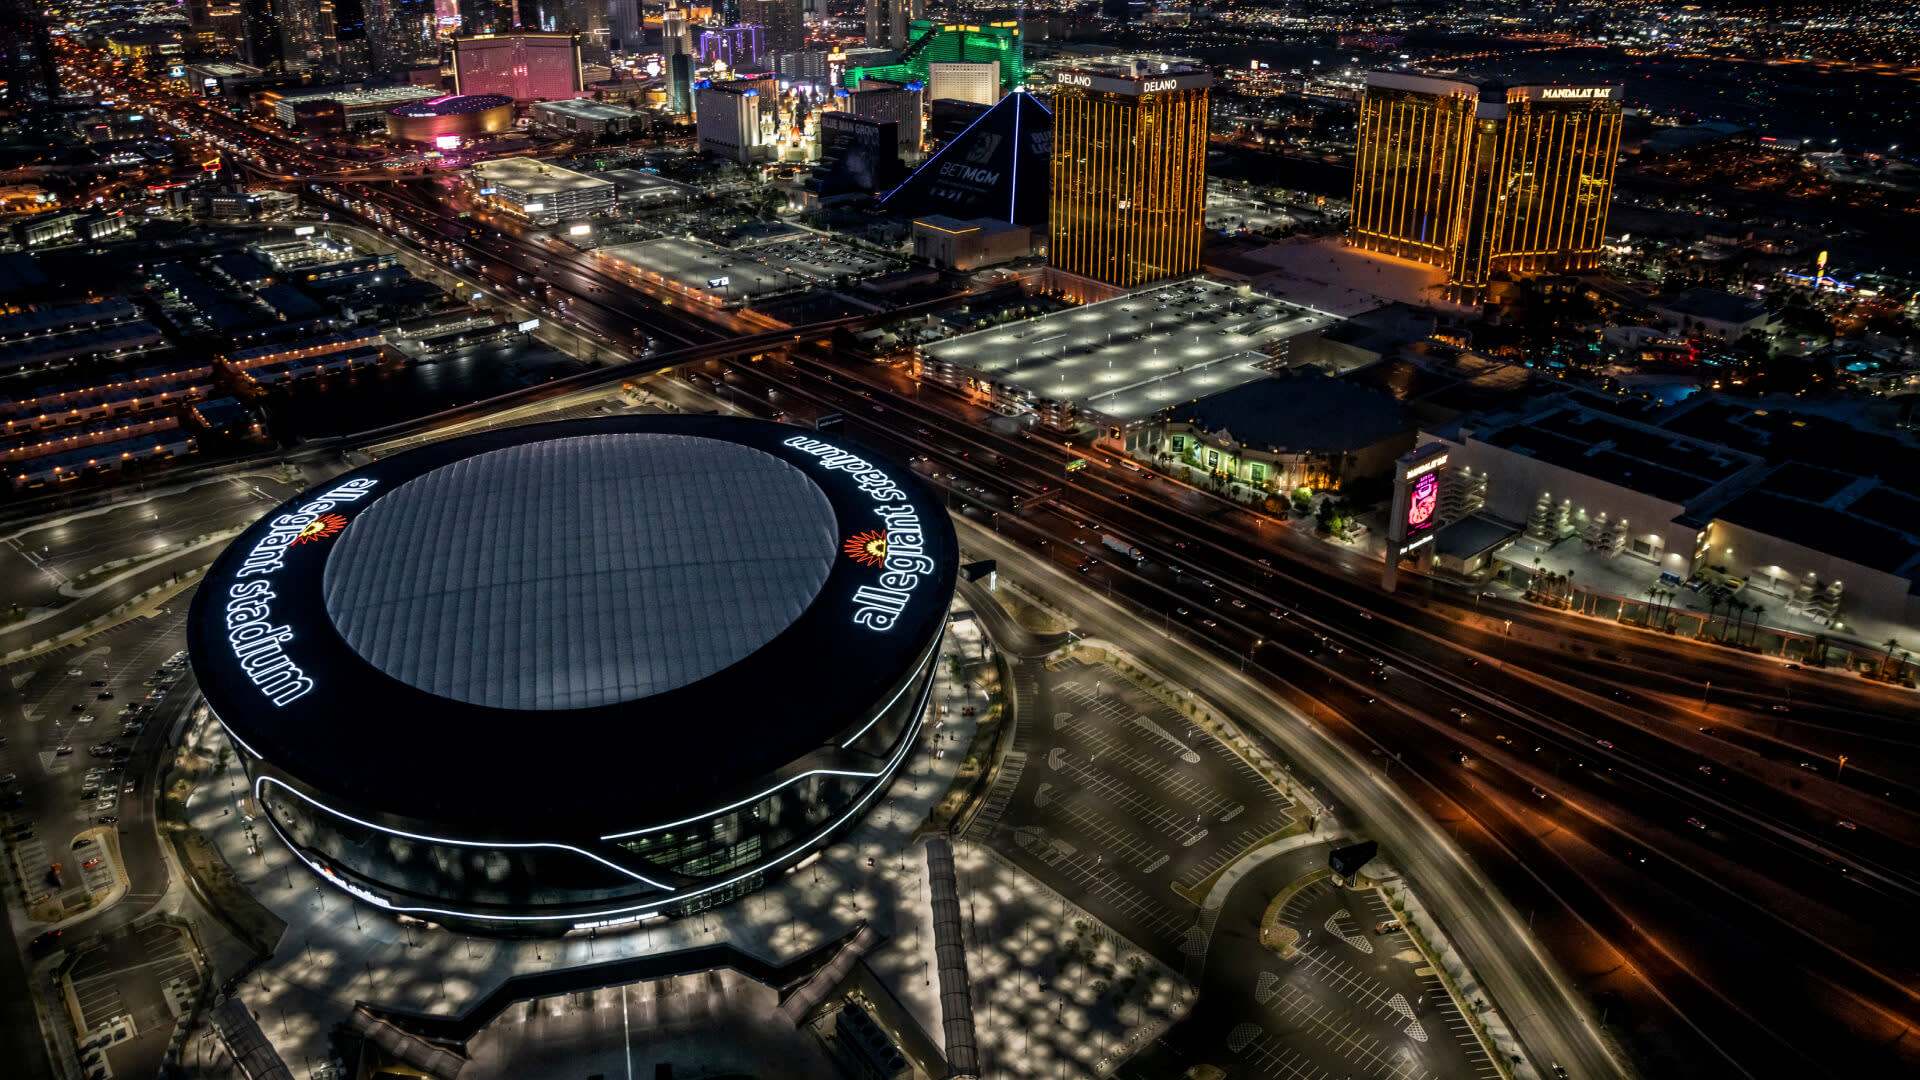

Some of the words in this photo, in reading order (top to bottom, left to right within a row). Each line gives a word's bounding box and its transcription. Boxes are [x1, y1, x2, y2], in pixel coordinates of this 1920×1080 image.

[1058, 73, 1091, 87] DELANO
[1143, 79, 1177, 93] DELANO
[1542, 88, 1593, 98] MANDALAY
[1593, 88, 1612, 98] BAY
[938, 161, 1000, 187] BETMGM
[783, 435, 907, 502] stadium
[236, 478, 379, 578] allegiant
[852, 504, 935, 631] allegiant
[226, 579, 314, 707] stadium
